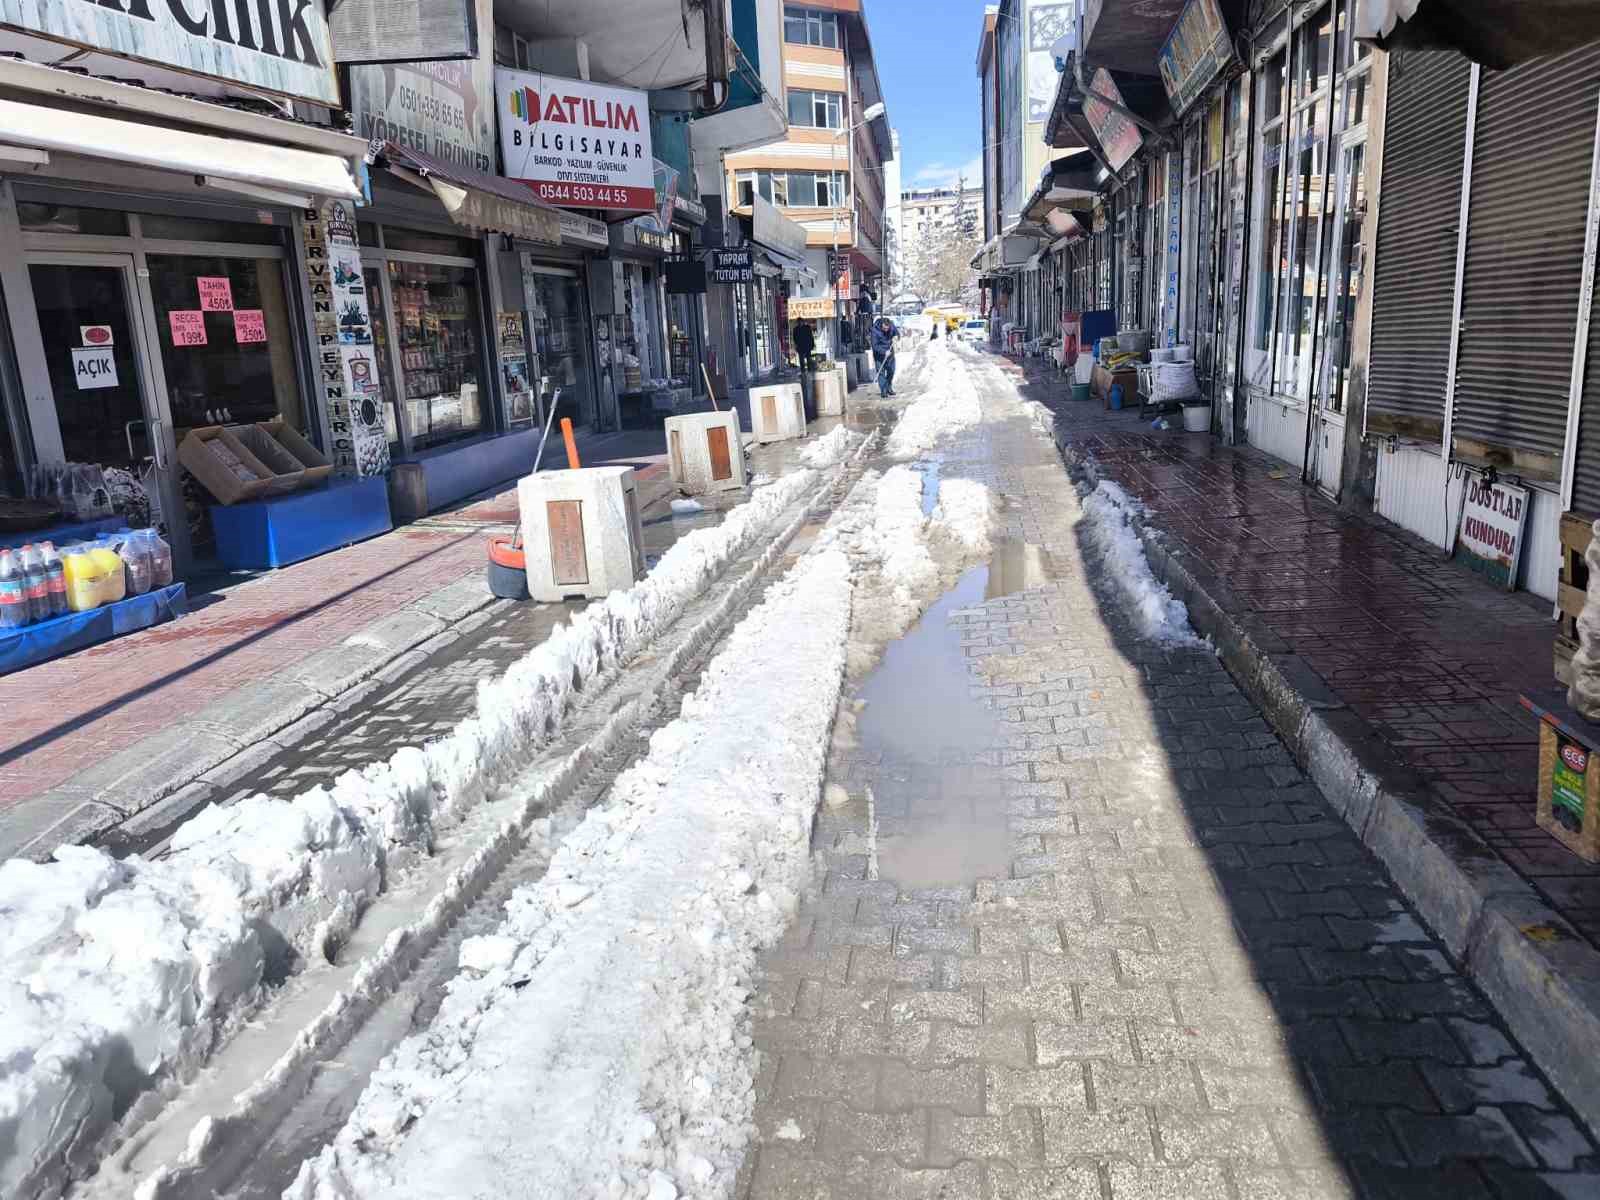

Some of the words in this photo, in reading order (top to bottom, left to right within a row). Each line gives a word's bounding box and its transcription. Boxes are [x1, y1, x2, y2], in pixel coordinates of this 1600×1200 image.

[544, 93, 640, 132] ATILIM
[513, 129, 643, 158] BİLGİSAYAR
[534, 155, 562, 167] BARKOD
[567, 157, 592, 169] YAZILIM
[597, 160, 627, 172] GÜVENLİK
[574, 171, 609, 184] SİSTEMLERİ
[540, 184, 570, 199] 0544
[573, 186, 594, 201] 503
[598, 188, 611, 202] 44
[614, 189, 628, 203] 55
[718, 253, 749, 265] YAPRAK
[715, 267, 739, 280] TÜTÜN
[77, 358, 111, 378] AÇIK
[1469, 480, 1522, 521] DOSTLAR
[1464, 515, 1516, 556] KUNDURA
